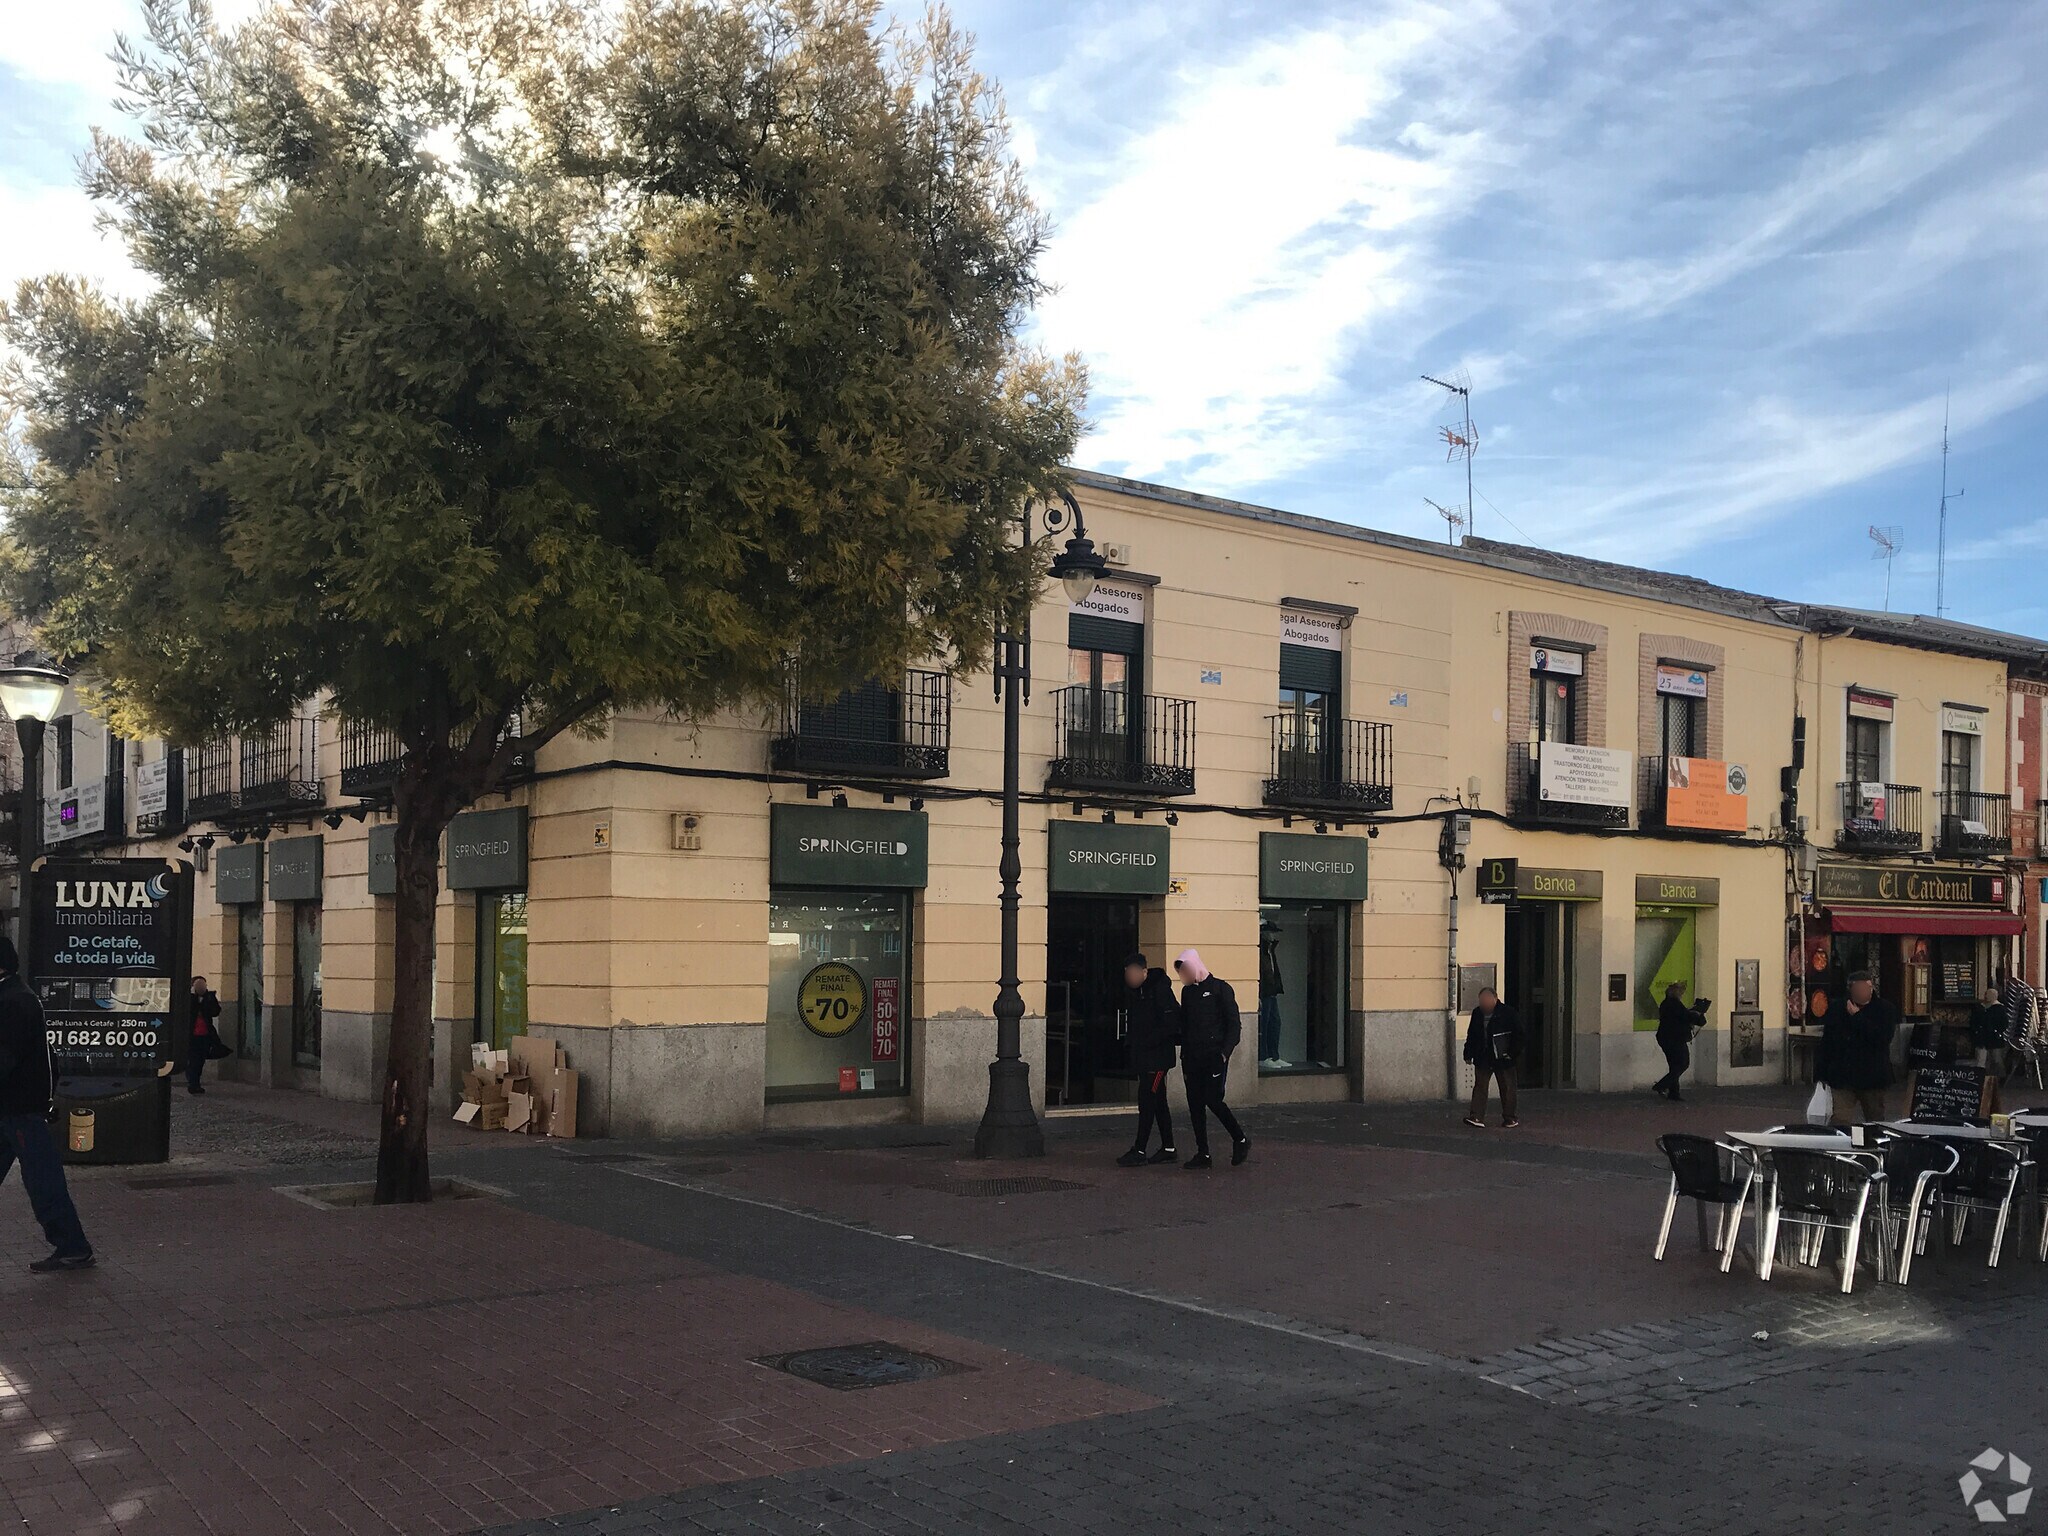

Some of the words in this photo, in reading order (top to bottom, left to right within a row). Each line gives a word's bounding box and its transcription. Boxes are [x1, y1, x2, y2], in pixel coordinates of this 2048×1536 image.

[1094, 584, 1143, 600] Asesores
[1075, 599, 1129, 615] Abogados
[1299, 616, 1341, 630] Asesores
[1284, 628, 1330, 643] Abogados
[1659, 677, 1672, 689] 25
[1554, 760, 1582, 769] TRASTORNOS
[455, 840, 510, 859] SPRINGFIELD
[799, 837, 908, 856] SPRINGFIELD
[1068, 850, 1157, 866] SPRINGFIELD
[1280, 859, 1355, 874] SPRINGFIELD
[1492, 861, 1505, 884] B
[1534, 874, 1576, 892] Bankia
[1660, 882, 1697, 899] Bankia
[1878, 871, 1899, 899] El
[1907, 873, 1974, 902] Cardenal
[55, 881, 153, 908] LUNA
[55, 910, 153, 926] Inmobiliaria
[68, 936, 89, 948] De
[91, 935, 142, 950] Getafe,
[54, 951, 73, 964] de
[75, 951, 109, 965] toda
[111, 951, 124, 964] la
[126, 951, 155, 965] vida
[815, 974, 851, 984] REMATE
[874, 980, 897, 989] REMATE
[820, 983, 845, 992] FINAL
[877, 988, 894, 998] FINAL
[45, 1019, 64, 1027] Calle
[64, 1019, 82, 1027] Luna
[90, 1019, 115, 1027] Getafe
[121, 1019, 137, 1028] 250
[45, 1030, 63, 1046] 91
[67, 1030, 101, 1046] 682
[105, 1030, 129, 1046] 60
[132, 1031, 157, 1047] 00
